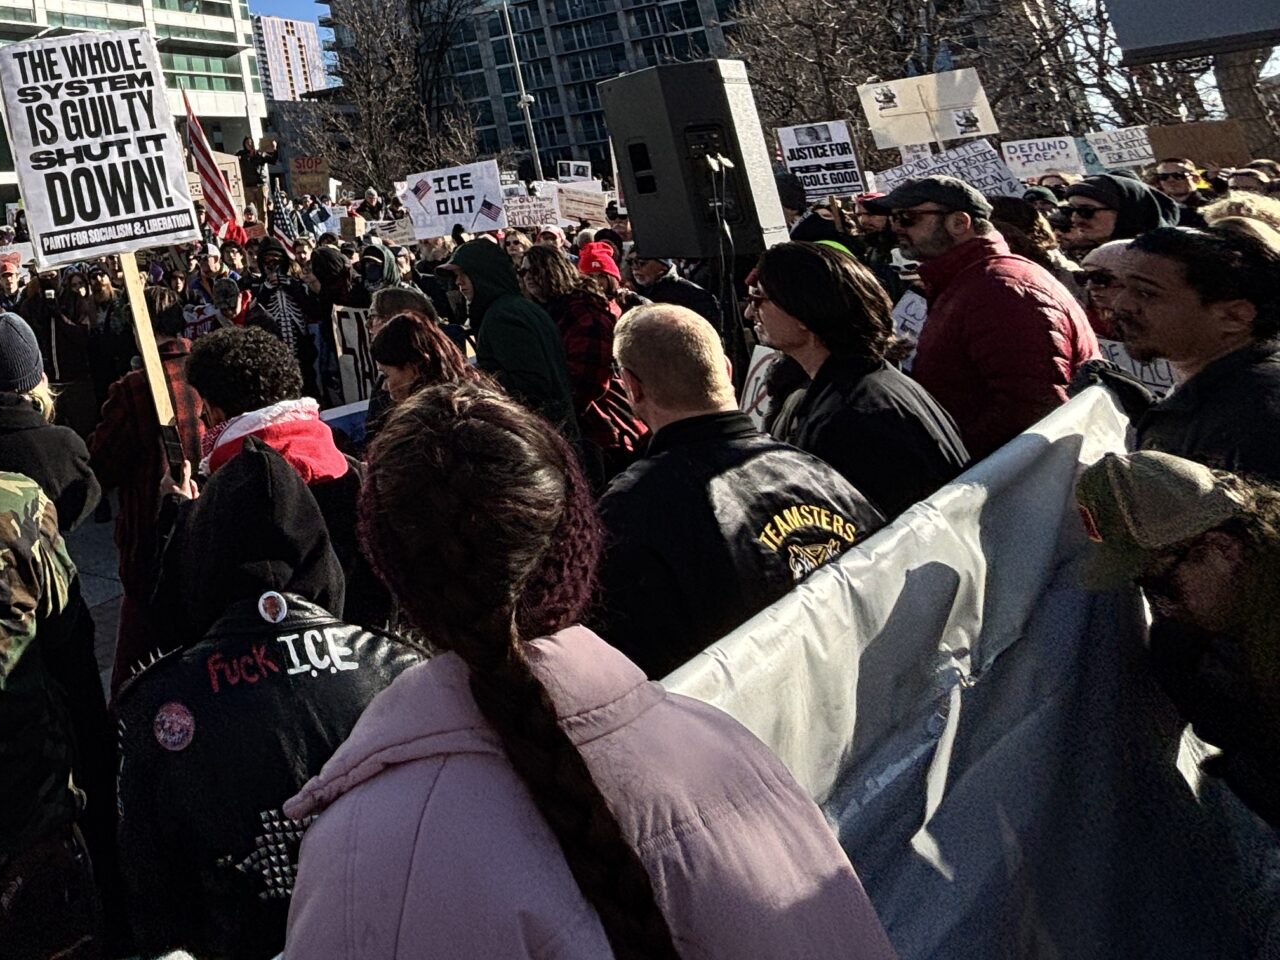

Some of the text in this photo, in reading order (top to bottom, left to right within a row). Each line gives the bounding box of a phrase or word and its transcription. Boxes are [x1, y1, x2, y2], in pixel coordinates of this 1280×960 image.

[13, 38, 147, 84] THE WHOLE
[17, 71, 155, 104] SYSTEM
[25, 90, 157, 147] IS GUILTY
[30, 133, 167, 171] SHUT IT
[787, 142, 853, 161] JUSTICE FOR
[1007, 140, 1068, 155] DEFUND
[1114, 140, 1151, 151] JUSTIC
[789, 160, 856, 174] RENEE
[830, 171, 860, 185] GOOD
[44, 155, 174, 227] DOWN!
[432, 172, 473, 194] ICE
[436, 195, 475, 216] OUT
[43, 212, 192, 252] PARTY FOR SOCIALISM & LIBERATION
[758, 504, 856, 552] TEAMSTERS
